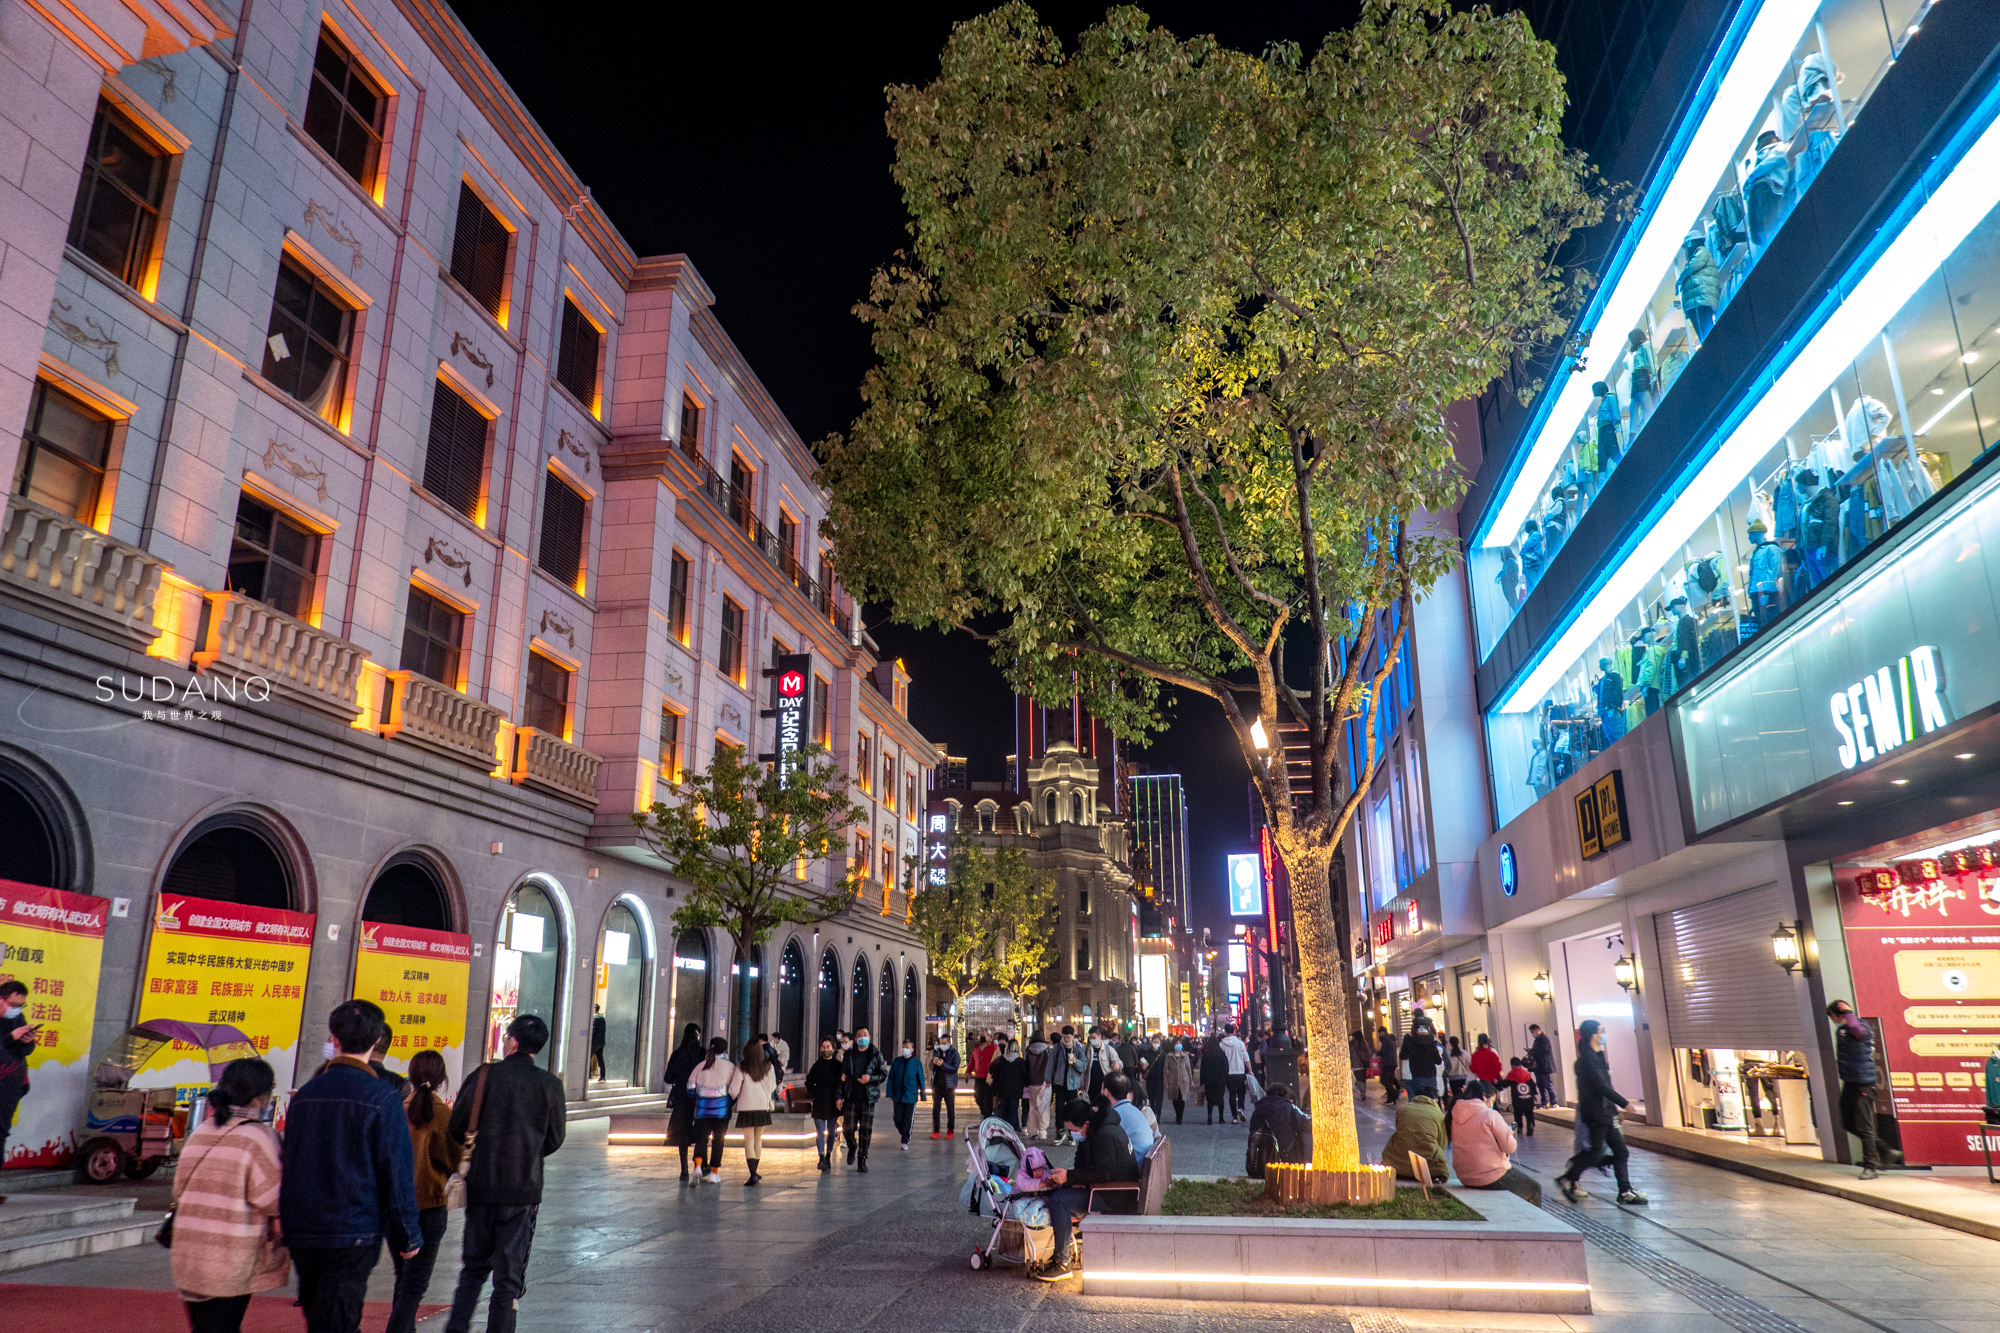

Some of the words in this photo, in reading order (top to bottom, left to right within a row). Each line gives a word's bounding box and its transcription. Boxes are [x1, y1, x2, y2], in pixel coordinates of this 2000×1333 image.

[783, 676, 801, 691] M
[779, 697, 803, 708] DAY
[1830, 645, 1948, 769] SEMIR
[1599, 785, 1612, 820] JPT
[1603, 818, 1619, 840] HOME
[13, 901, 101, 927] 做文明有礼武汉人
[188, 914, 252, 932] 创建全国文明城市
[255, 922, 310, 938] 做文明有礼武汉人
[430, 942, 470, 956] 做文明有礼武汉人
[166, 951, 295, 973] 实现中华民族伟大复兴的中国梦
[403, 969, 430, 981] 武汉精神
[33, 977, 65, 997] 和谐
[150, 978, 198, 995] 国家富强
[210, 981, 254, 997] 民族振兴
[261, 984, 301, 999] 人民幸福
[379, 989, 412, 1003] 敢为人先
[417, 992, 448, 1006] 追求卓越
[31, 1003, 62, 1022] 法治
[208, 1010, 246, 1023] 武汉精神
[399, 1014, 426, 1025] 志愿精神
[391, 1035, 408, 1048] 友爱
[413, 1036, 428, 1048] 互助
[433, 1036, 449, 1048] 进步
